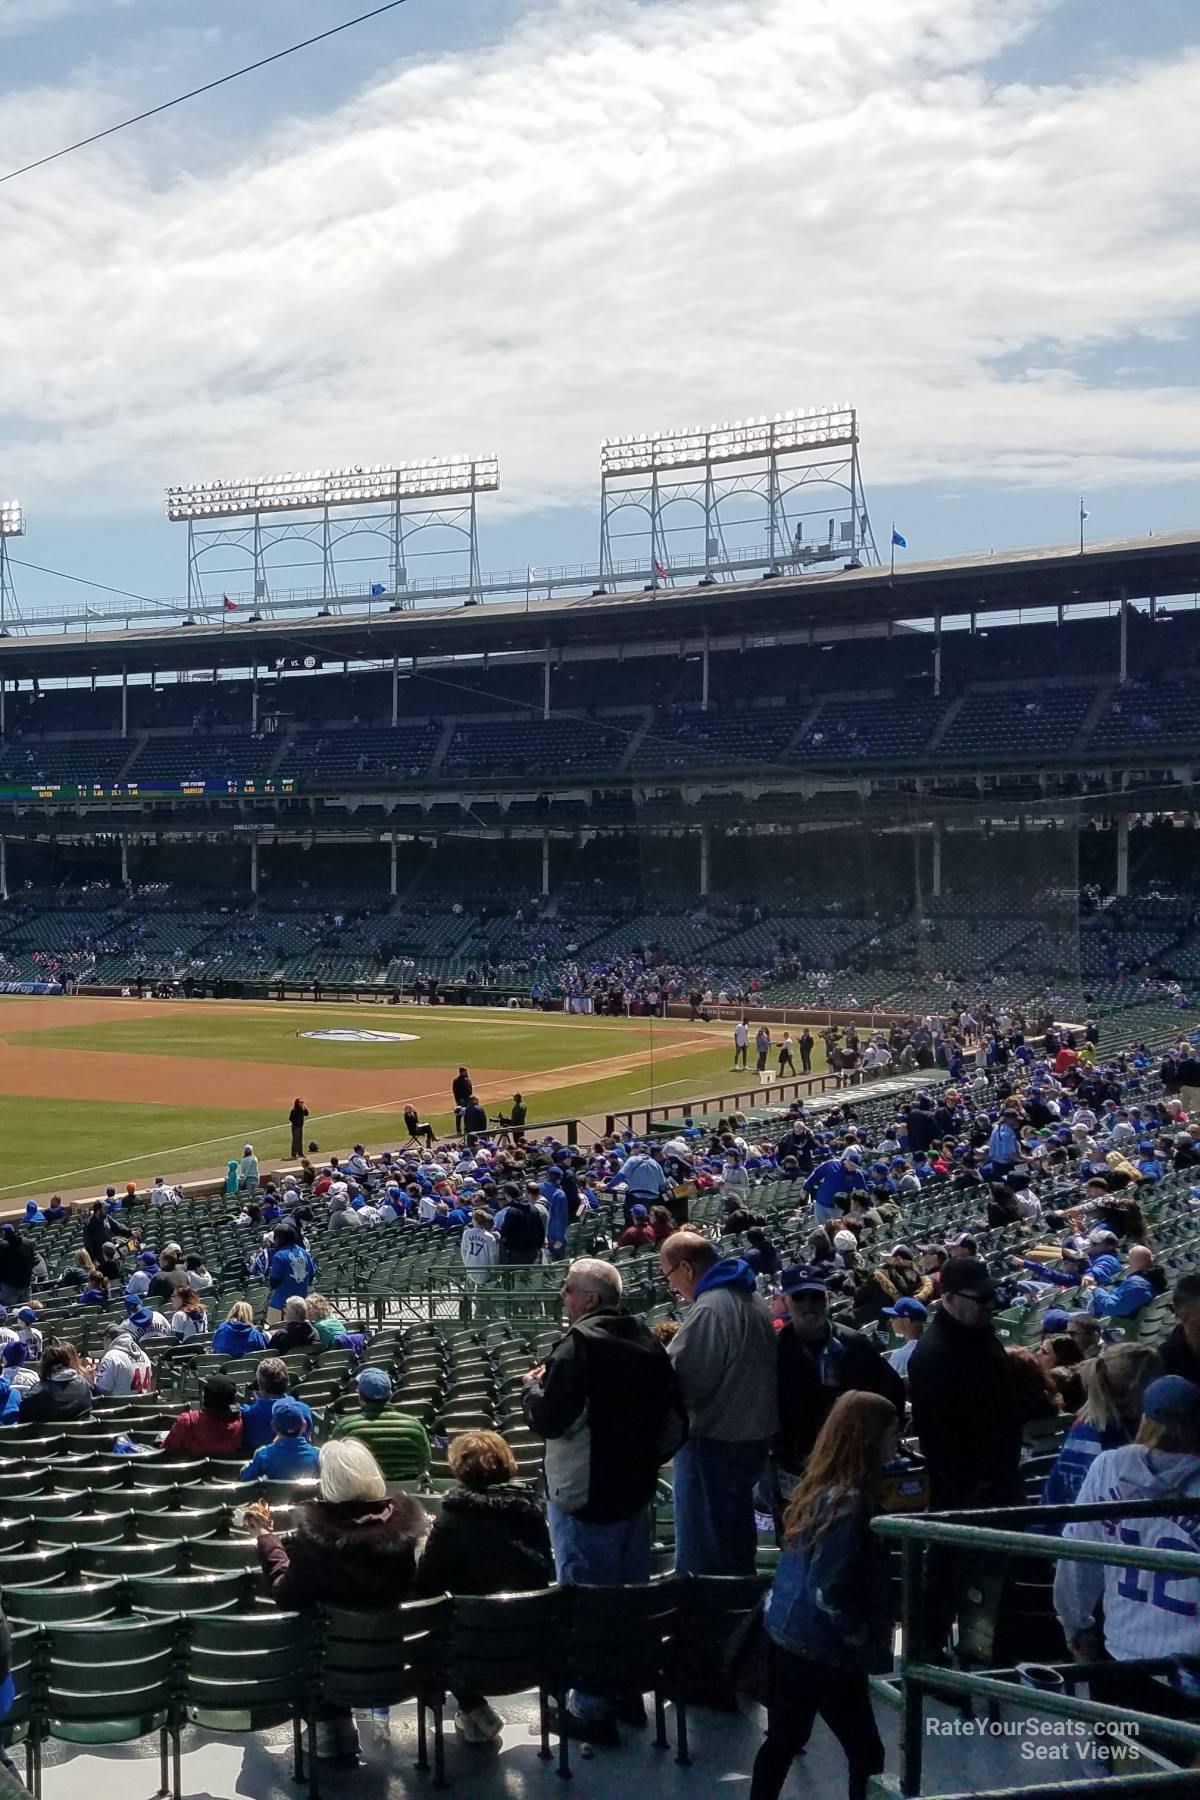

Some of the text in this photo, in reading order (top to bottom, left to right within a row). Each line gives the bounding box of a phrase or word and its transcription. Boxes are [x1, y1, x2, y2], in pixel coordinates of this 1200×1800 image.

[8, 983, 34, 994] Wrap
[469, 1242, 484, 1256] 17
[131, 1366, 153, 1392] 44
